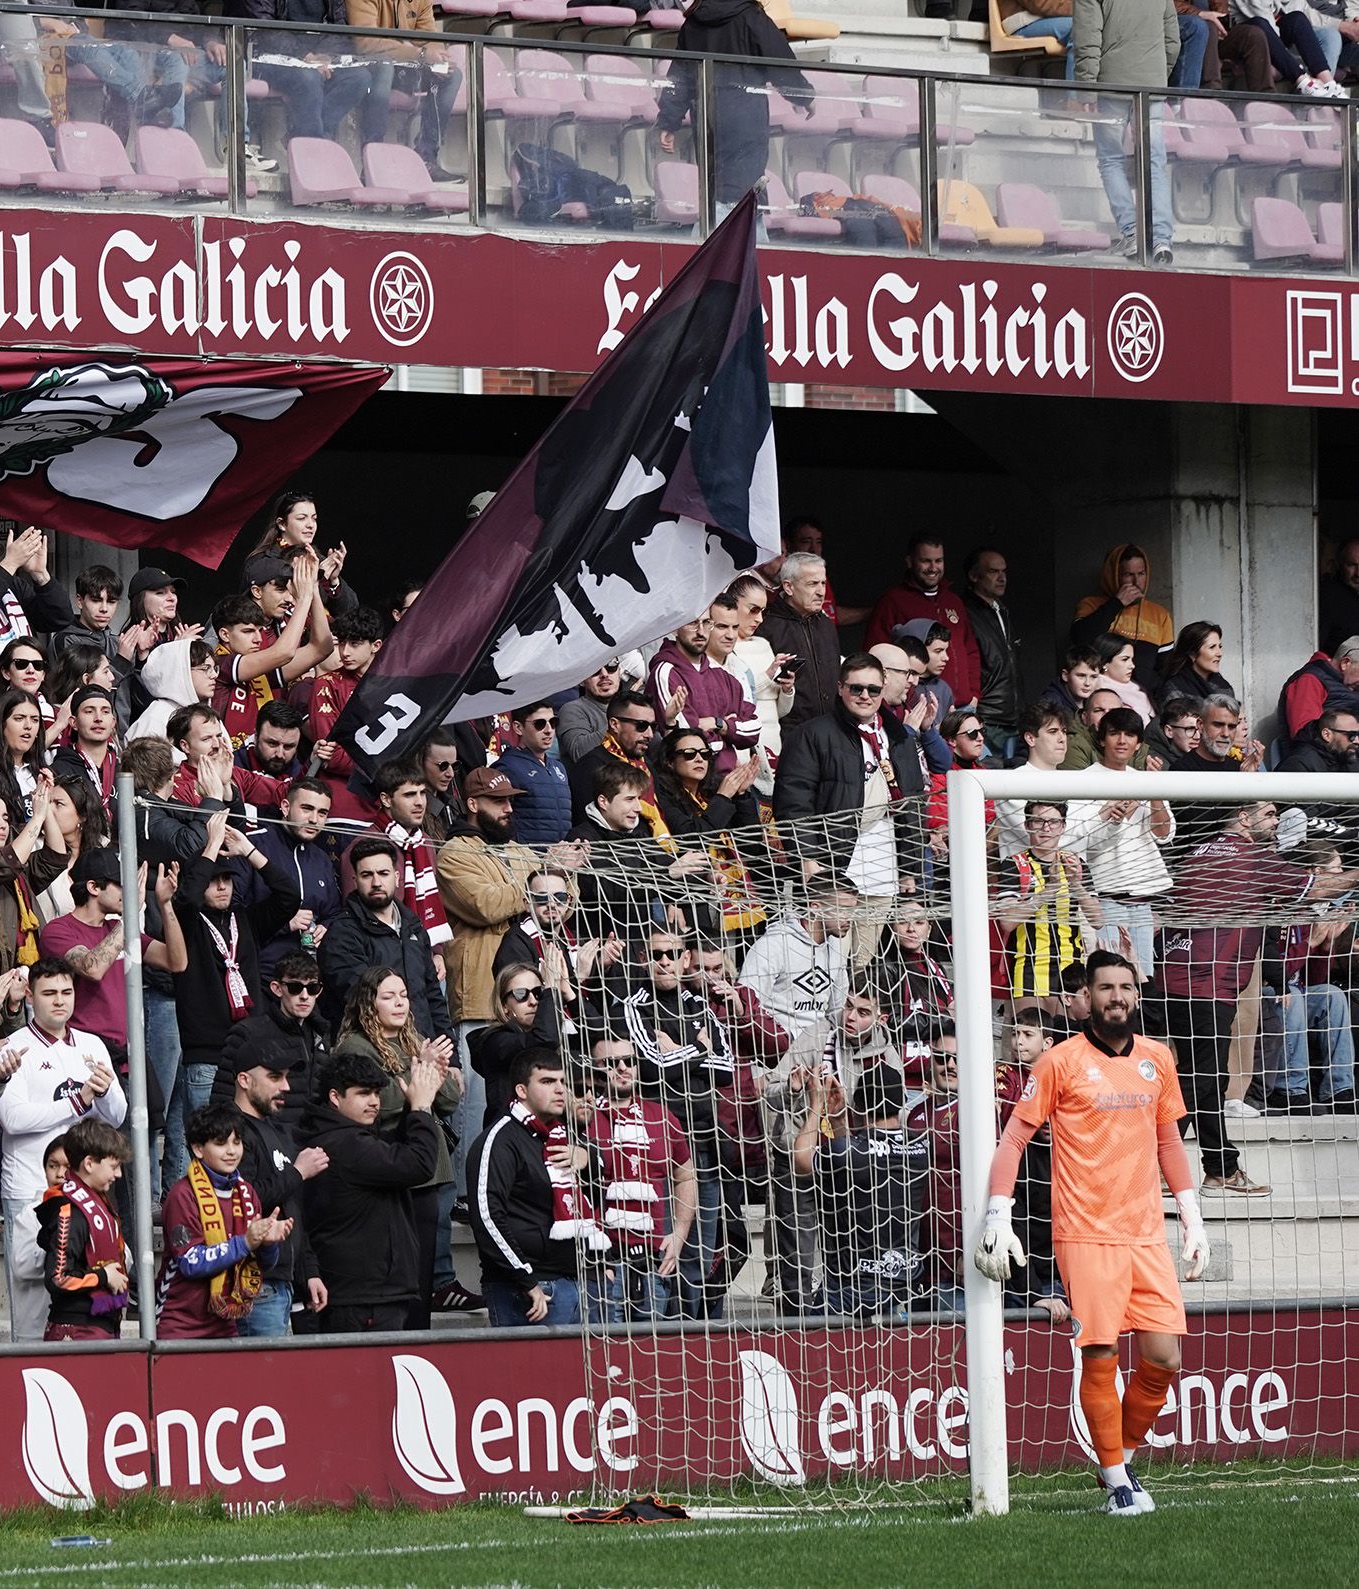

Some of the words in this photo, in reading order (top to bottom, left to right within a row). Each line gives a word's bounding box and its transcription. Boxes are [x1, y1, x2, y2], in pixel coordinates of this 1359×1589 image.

[97, 228, 351, 344] Galicia
[867, 271, 1091, 381] Galicia
[794, 998, 829, 1011] umbr
[103, 1405, 286, 1491] ence
[471, 1395, 640, 1474] ence
[817, 1384, 970, 1465] ence
